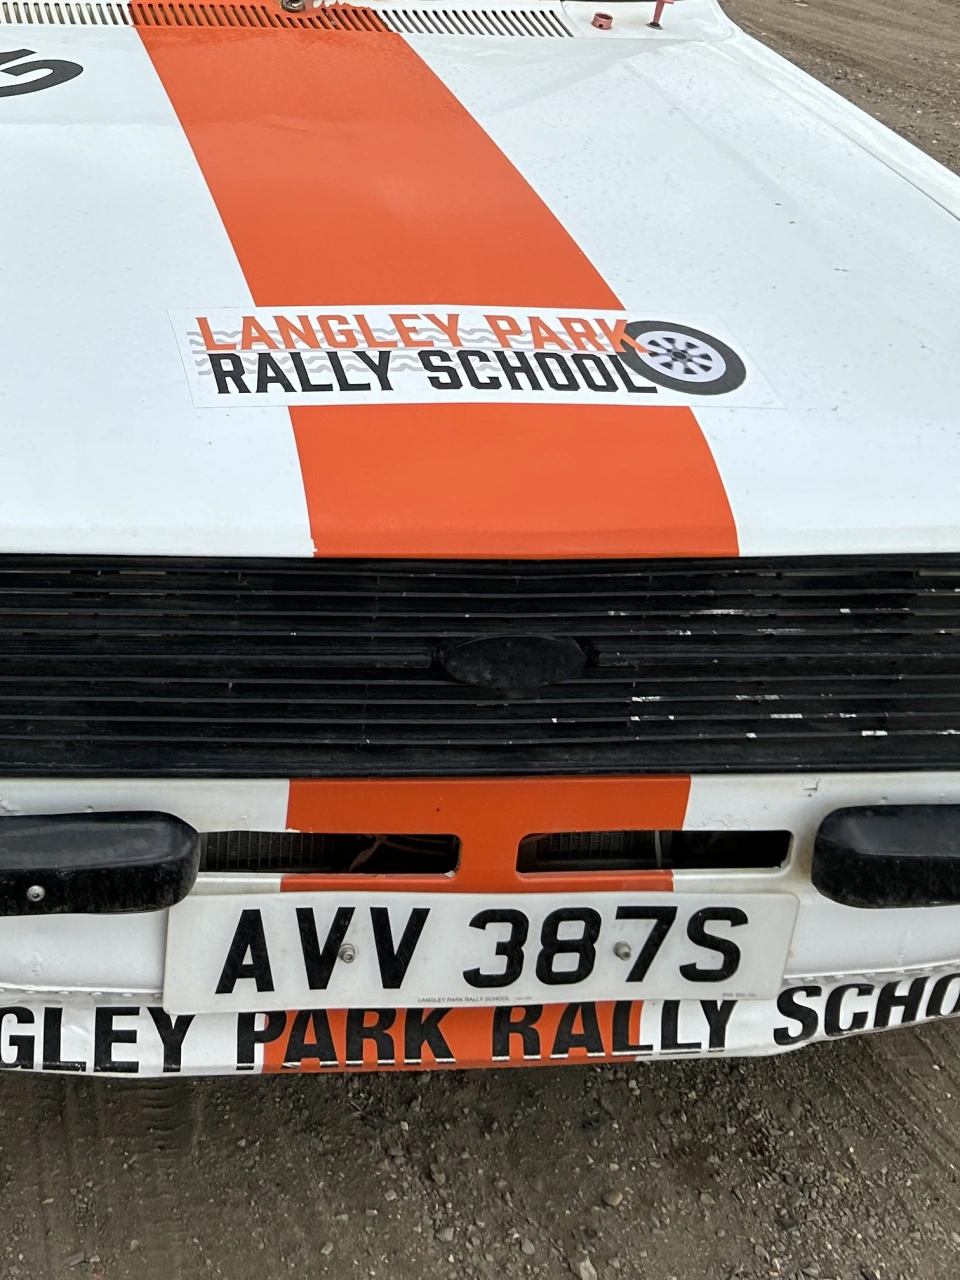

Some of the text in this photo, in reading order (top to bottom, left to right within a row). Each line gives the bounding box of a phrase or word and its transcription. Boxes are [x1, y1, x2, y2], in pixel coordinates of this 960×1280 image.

[195, 313, 649, 353] LANGLEY PARK
[211, 350, 658, 394] RALLY SCHOOL
[214, 905, 751, 994] AVV 387S
[236, 1006, 457, 1071] PARK
[492, 1000, 737, 1062] RALLY
